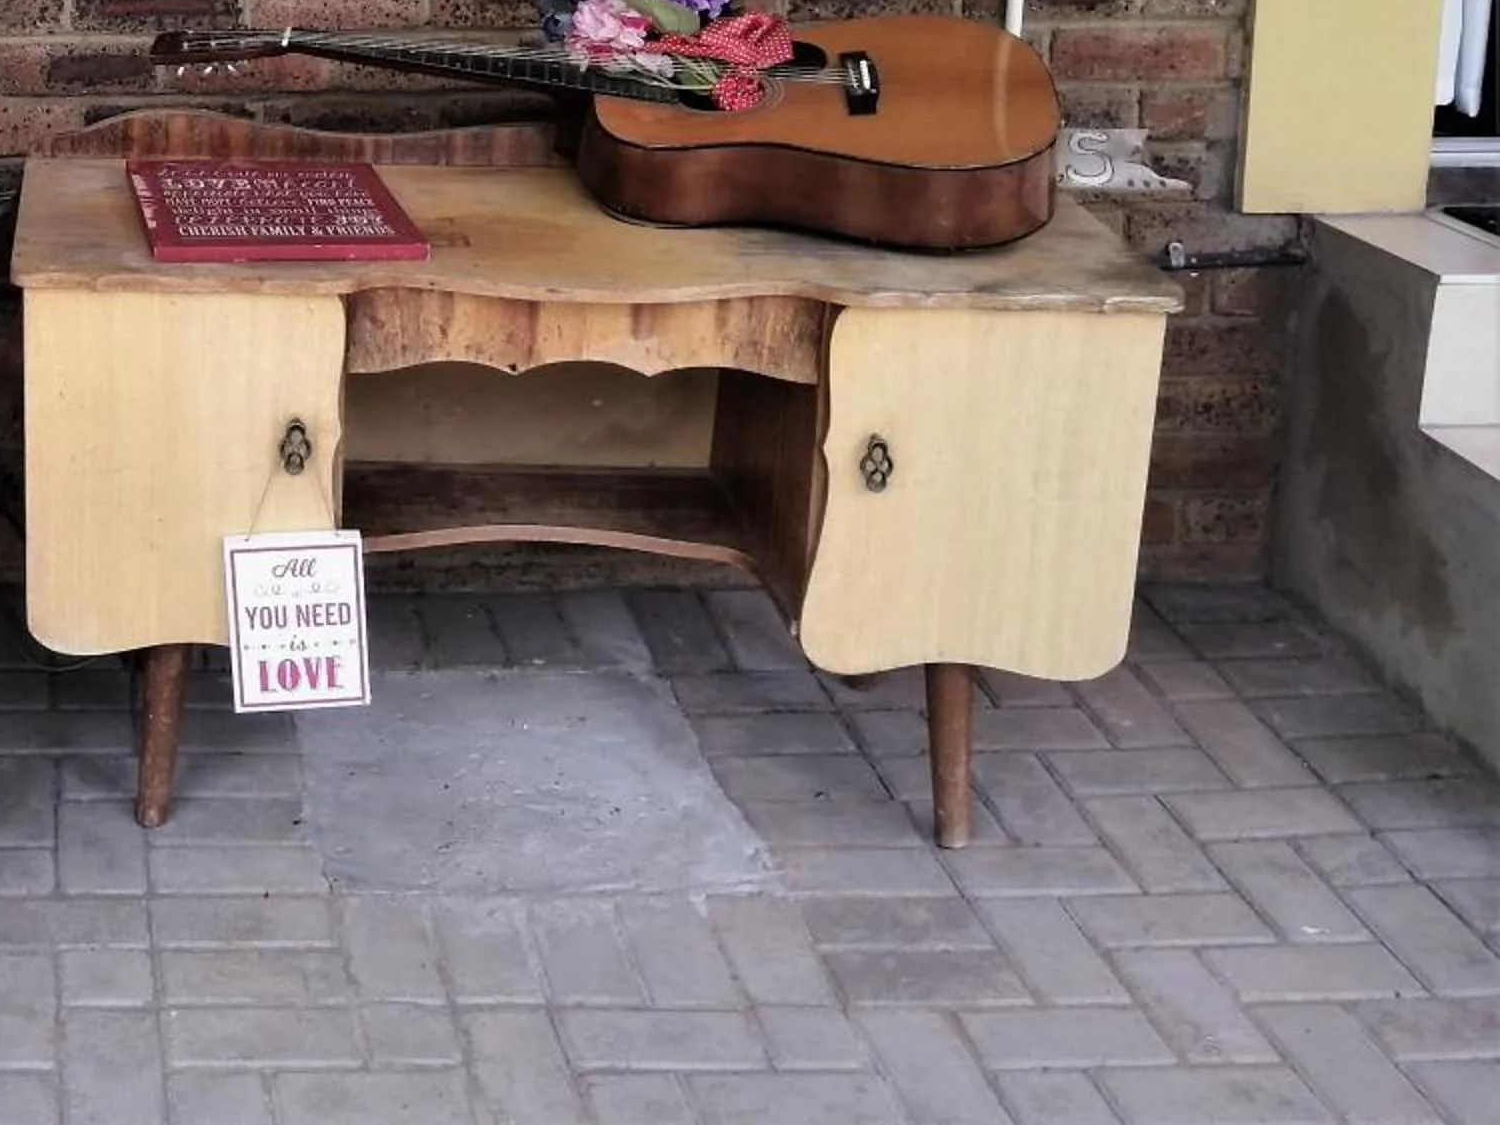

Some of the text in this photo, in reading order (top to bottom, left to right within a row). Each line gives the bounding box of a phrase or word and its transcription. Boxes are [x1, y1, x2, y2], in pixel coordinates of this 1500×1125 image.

[179, 225, 396, 236] CHERISH FAMILY & FRIENDS
[271, 558, 318, 577] All
[244, 602, 351, 630] YOU NEED
[289, 634, 308, 651] is
[258, 655, 344, 693] LOVE
